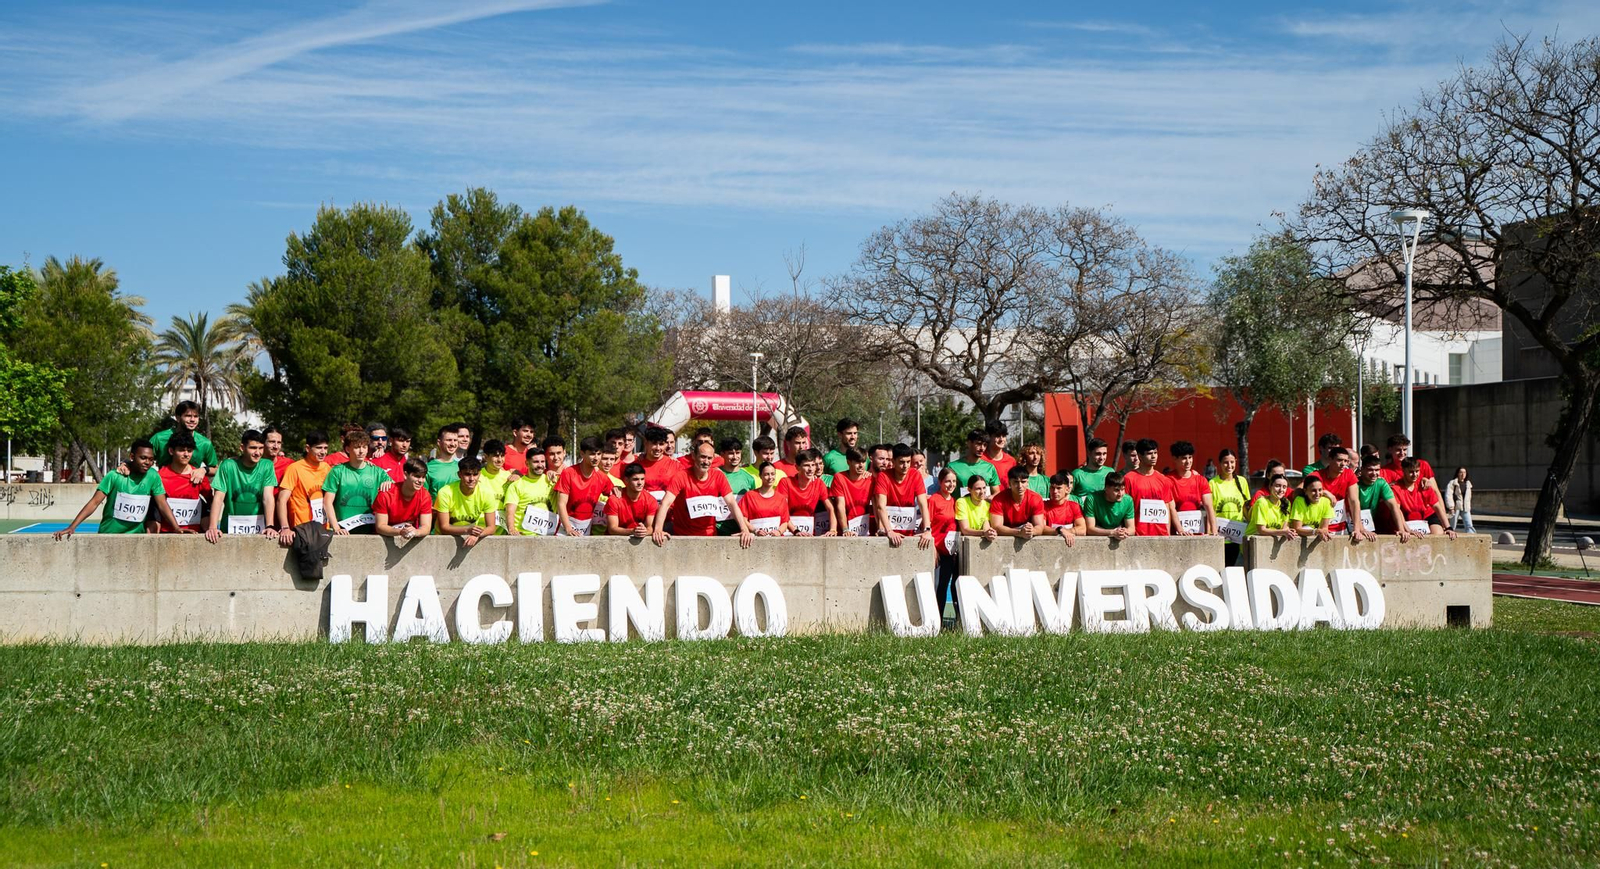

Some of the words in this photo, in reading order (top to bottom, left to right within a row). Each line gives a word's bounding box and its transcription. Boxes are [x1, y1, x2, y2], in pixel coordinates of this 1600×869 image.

[712, 403, 744, 411] Universidad
[118, 503, 146, 515] 15079
[692, 503, 718, 513] 15079
[1144, 508, 1167, 517] 15079
[527, 515, 554, 529] 15079
[1180, 519, 1202, 528] 15079
[233, 525, 260, 534] 15079
[1217, 525, 1241, 537] 15079
[330, 572, 788, 644] HACIENDO
[880, 564, 1386, 638] UNIVERSIDAD
